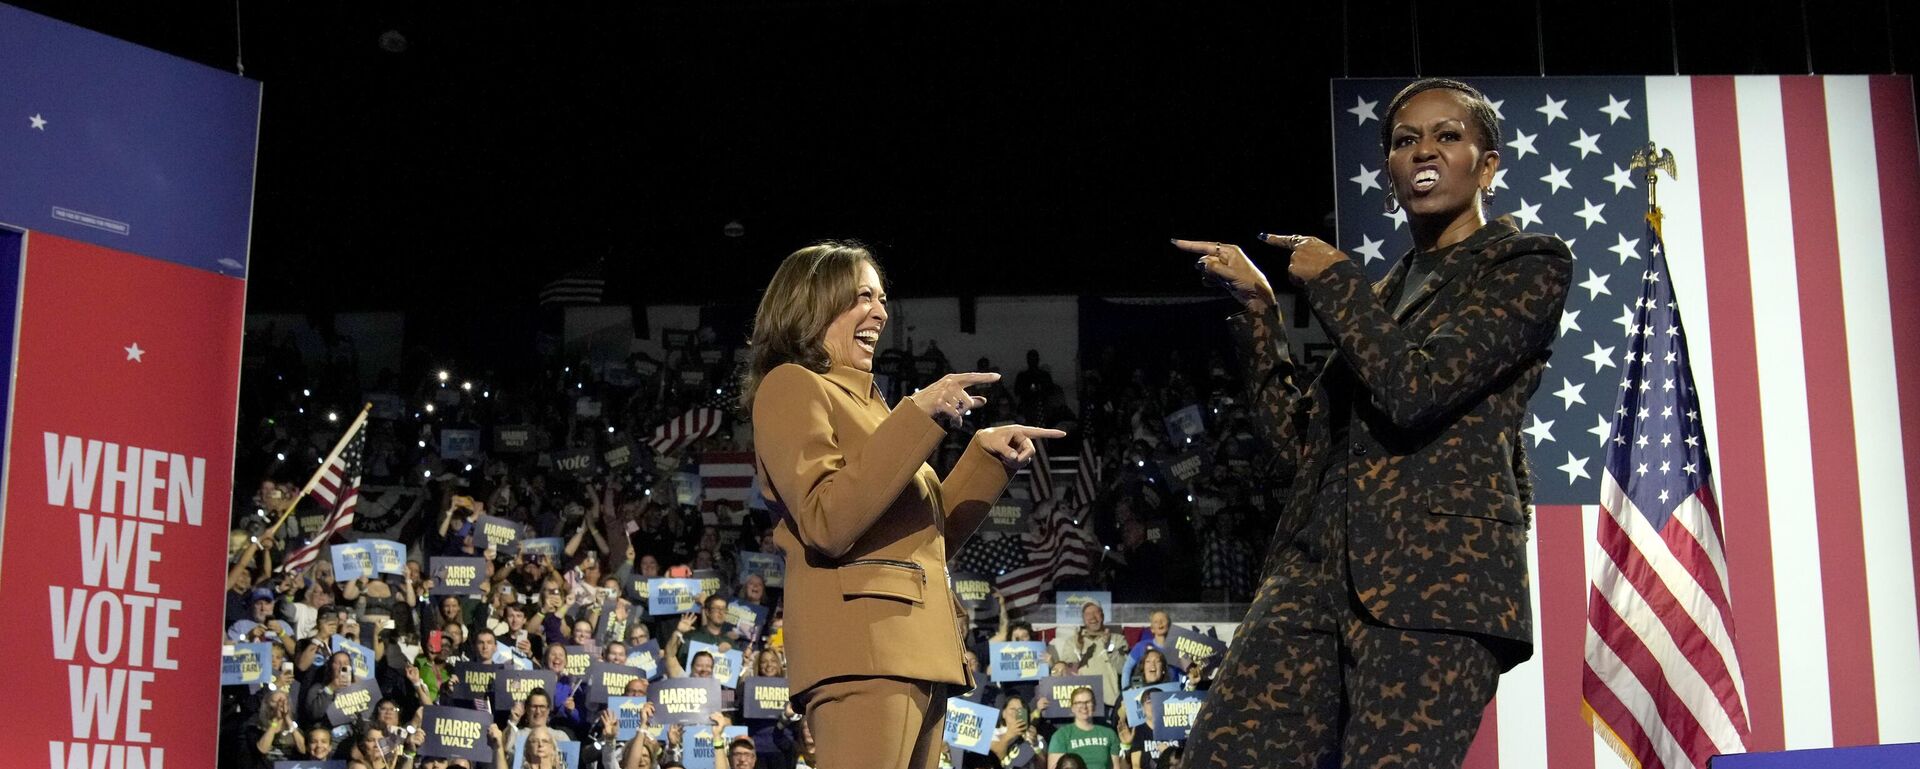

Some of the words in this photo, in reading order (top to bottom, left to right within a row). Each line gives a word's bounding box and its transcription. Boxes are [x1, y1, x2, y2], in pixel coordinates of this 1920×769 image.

[556, 454, 591, 471] vote
[44, 431, 206, 527] WHEN
[484, 523, 516, 540] HARRIS
[79, 512, 164, 594] WE
[446, 566, 476, 580] ARRIS
[446, 578, 471, 587] WALZ
[956, 580, 991, 593] HARRIS
[960, 591, 986, 601] WALZ
[49, 585, 183, 670] VOTE
[1175, 637, 1213, 657] HARRIS
[567, 654, 591, 668] RRIS
[1000, 661, 1019, 671] VOTES
[335, 689, 371, 709] HARRIS
[659, 688, 708, 705] HARRIS
[755, 686, 789, 702] HARRIS
[68, 664, 154, 745] WE
[667, 703, 701, 714] WALZ
[760, 700, 786, 711] WALZ
[947, 709, 984, 729] ICHIGAN
[1163, 715, 1189, 727] VOTES
[435, 718, 482, 740] HARRIS
[958, 724, 983, 739] EARLY
[440, 735, 474, 749] WALZ
[1070, 737, 1108, 749] HARRIS
